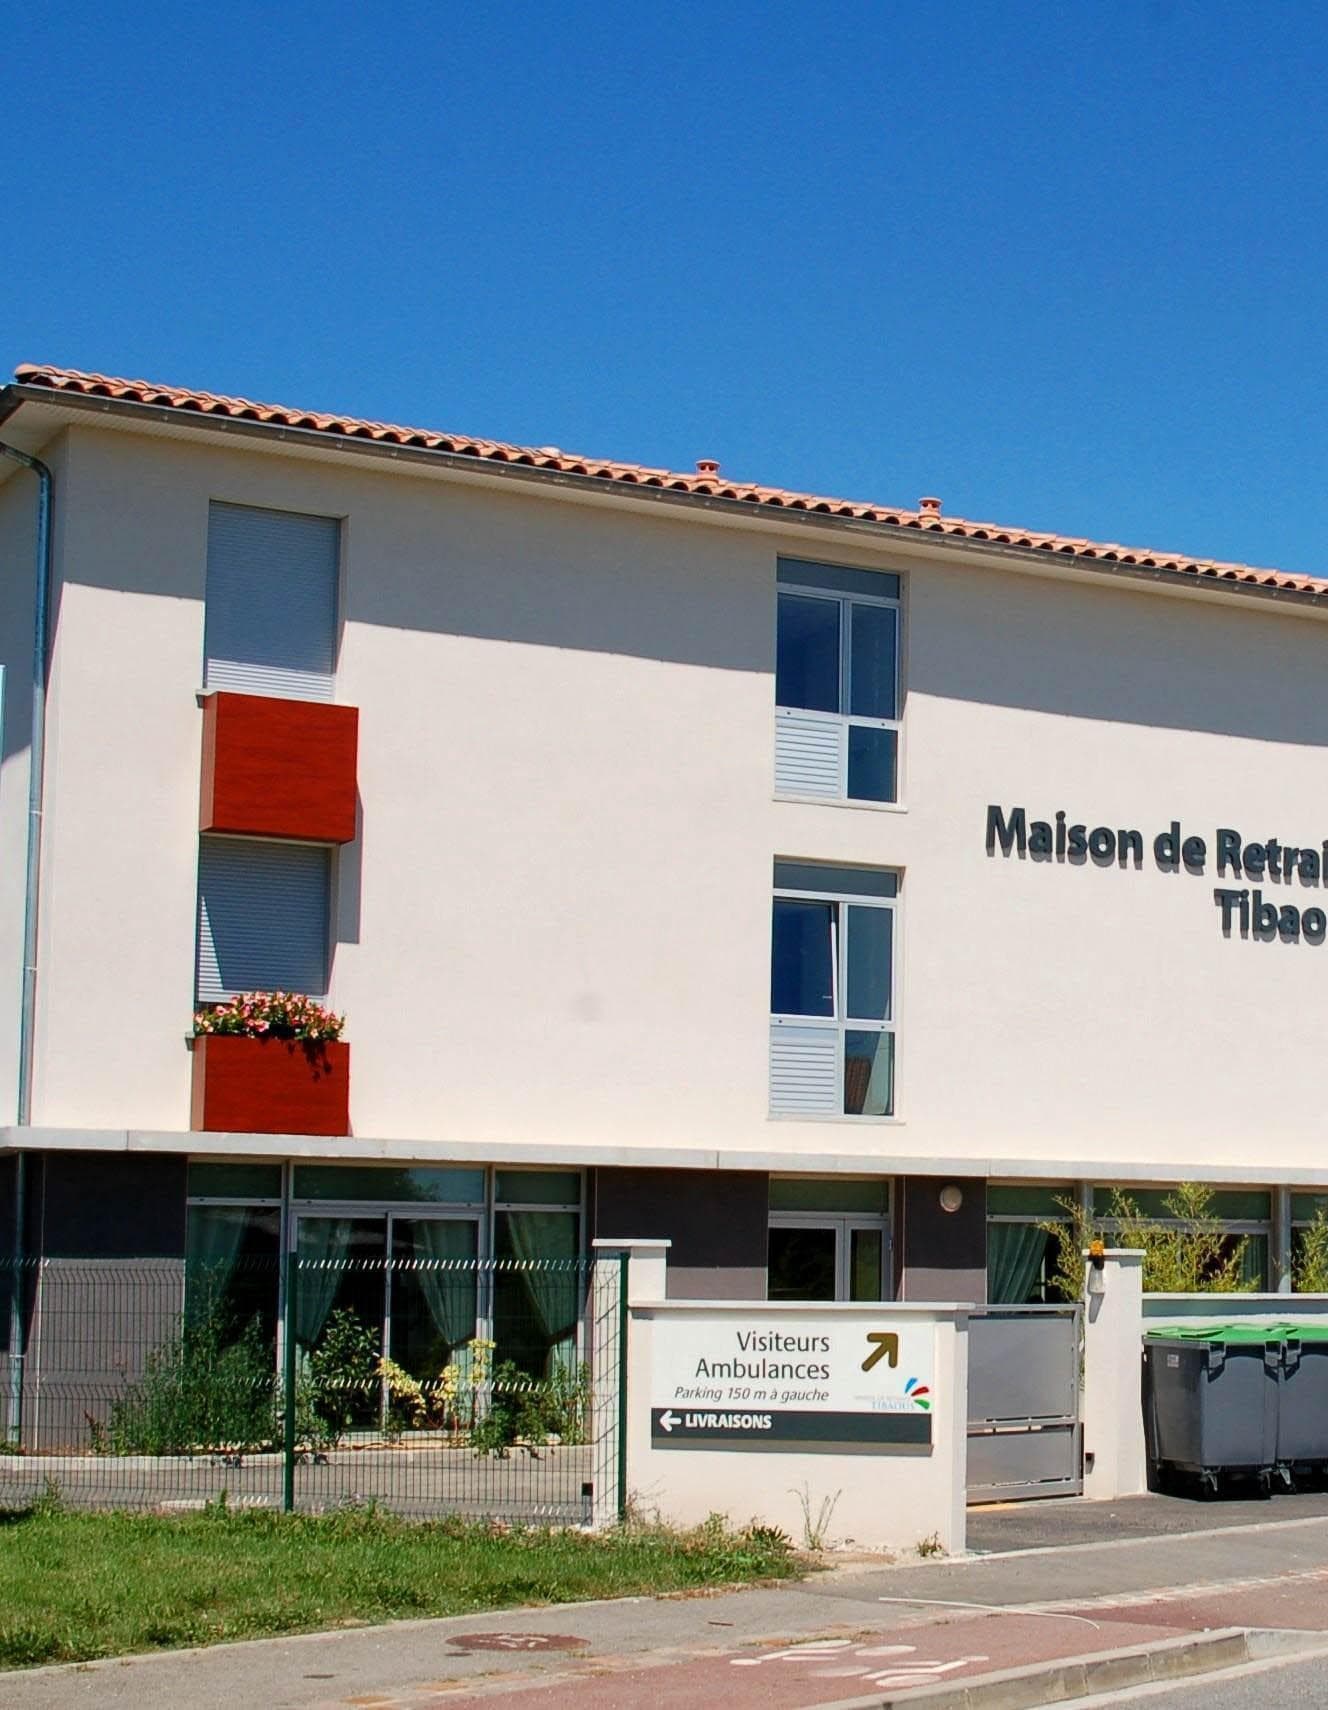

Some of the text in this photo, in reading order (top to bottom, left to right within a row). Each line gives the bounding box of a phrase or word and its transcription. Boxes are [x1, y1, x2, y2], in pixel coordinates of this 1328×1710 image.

[986, 805, 1144, 863] Maison
[1153, 821, 1207, 867] de
[737, 1331, 830, 1352] Visiteurs
[695, 1358, 830, 1379] Ambulances
[674, 1386, 830, 1403] Parking 150 m à gauche
[685, 1413, 772, 1429] LIVRAISONS
